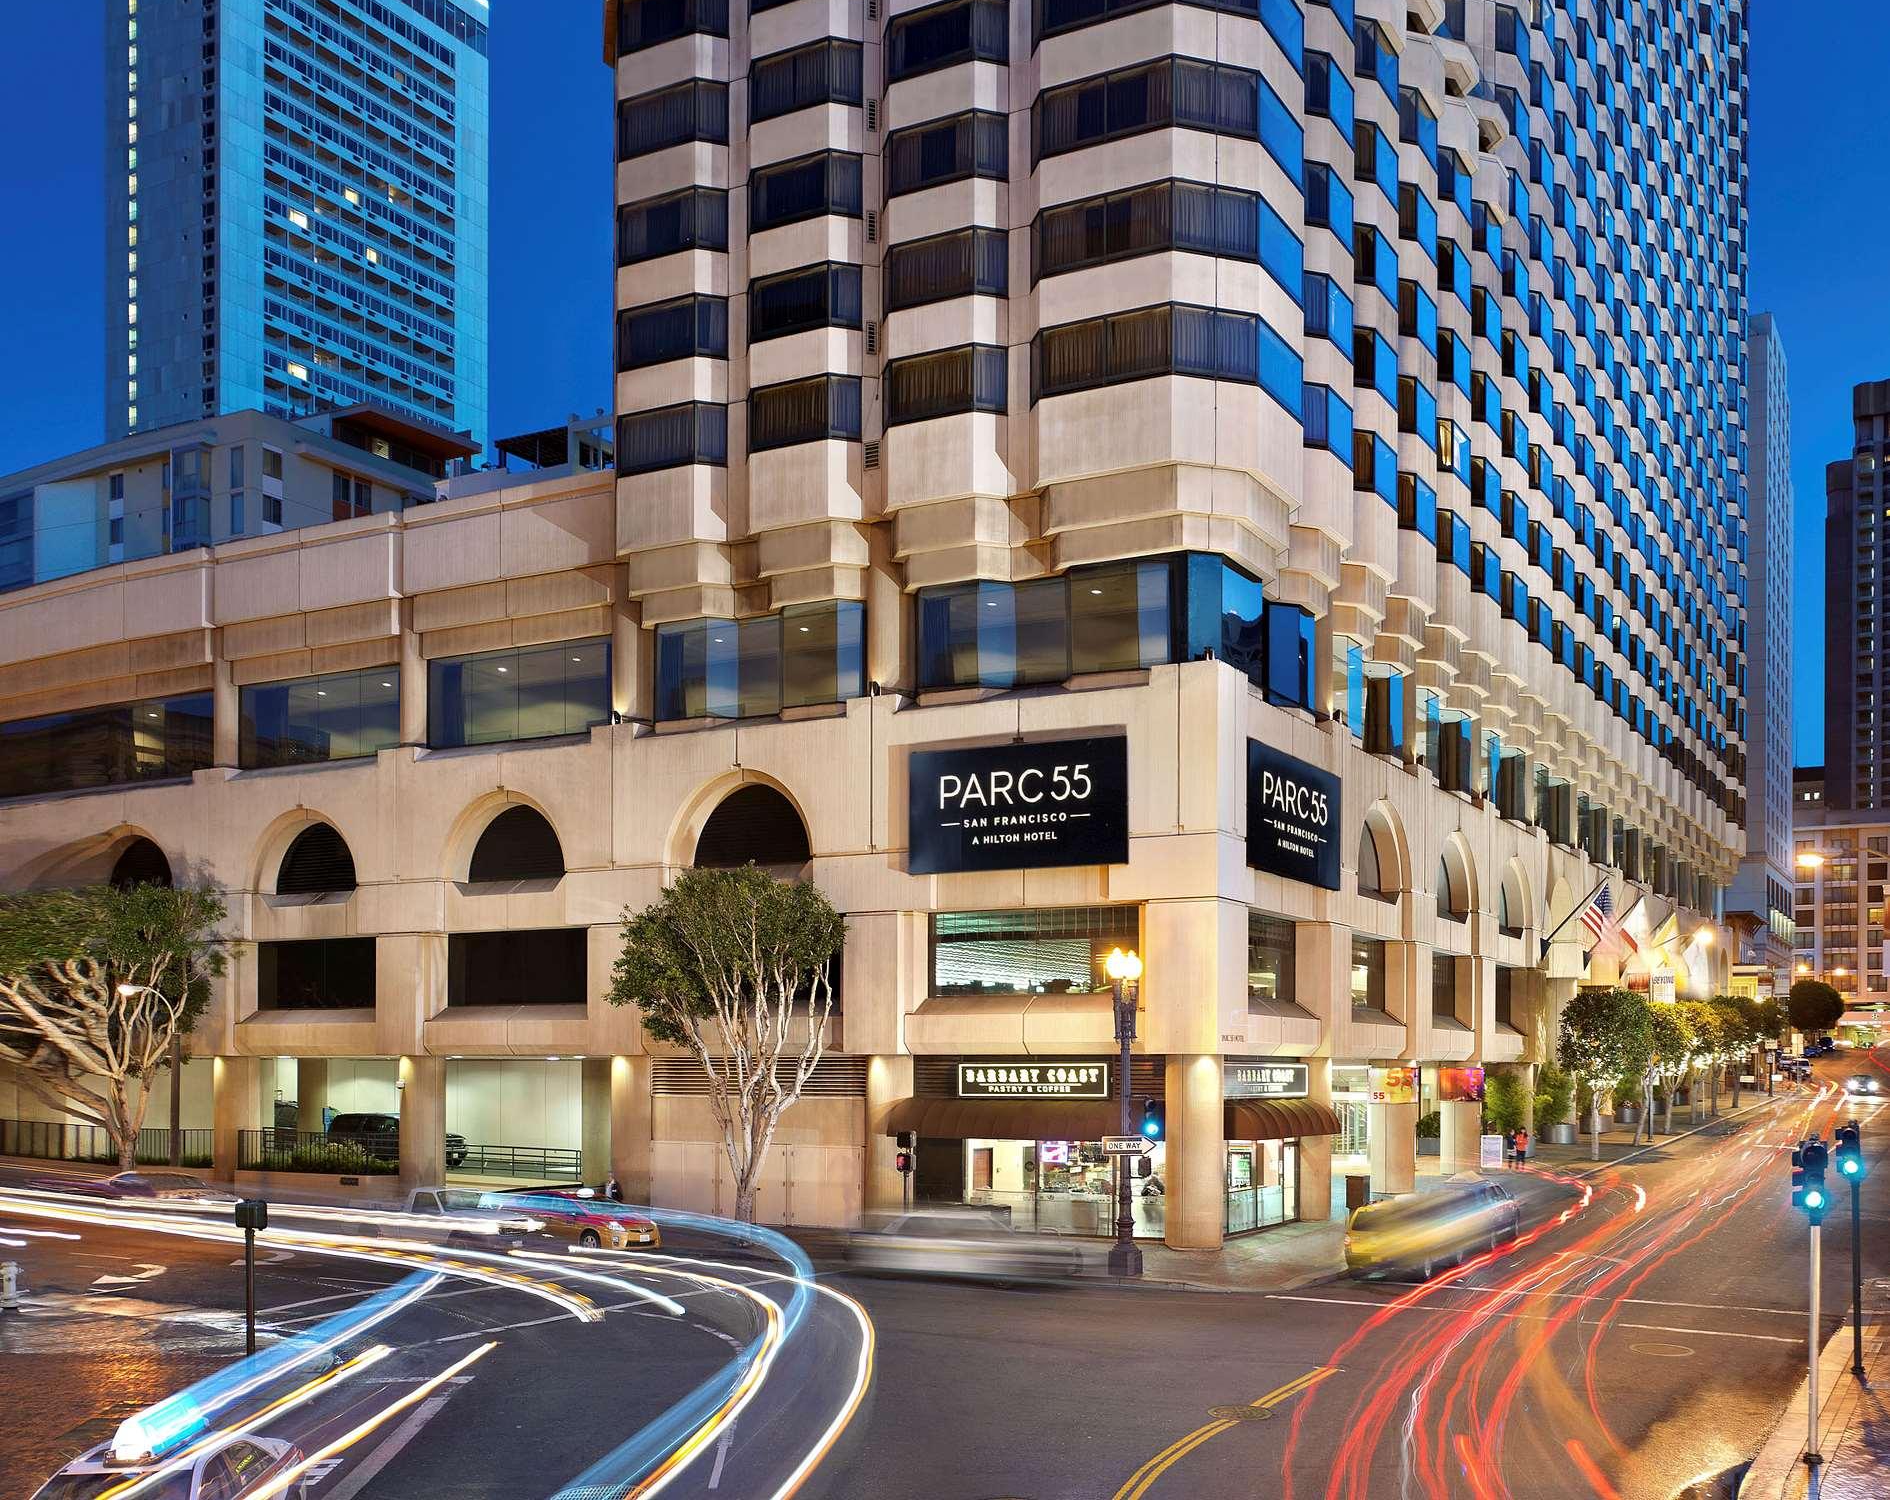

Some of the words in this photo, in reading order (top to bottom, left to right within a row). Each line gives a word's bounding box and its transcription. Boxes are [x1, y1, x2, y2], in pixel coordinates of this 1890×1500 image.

[939, 768, 1044, 810] PARC
[1050, 763, 1092, 801] 55
[1262, 770, 1309, 819] PARC
[1310, 790, 1328, 827] 55
[963, 817, 988, 829] SAN
[993, 812, 1067, 826] FRANCISCO
[971, 836, 980, 845] A
[983, 833, 1020, 845] HILTON
[1023, 831, 1058, 842] HOTEL
[1273, 819, 1286, 831] SAN
[1286, 823, 1318, 843] FRANCISCO
[1277, 837, 1282, 847] A
[1281, 840, 1299, 853] HILTON
[1299, 845, 1315, 858] HOTEL
[965, 1068, 1040, 1083] BARBARY
[1046, 1068, 1099, 1083] COAST
[988, 1085, 1023, 1093] PASTRY
[1026, 1085, 1033, 1093] &
[1036, 1085, 1071, 1093] COFFEE
[1373, 1091, 1385, 1100] 55
[1108, 1142, 1123, 1150] ONE
